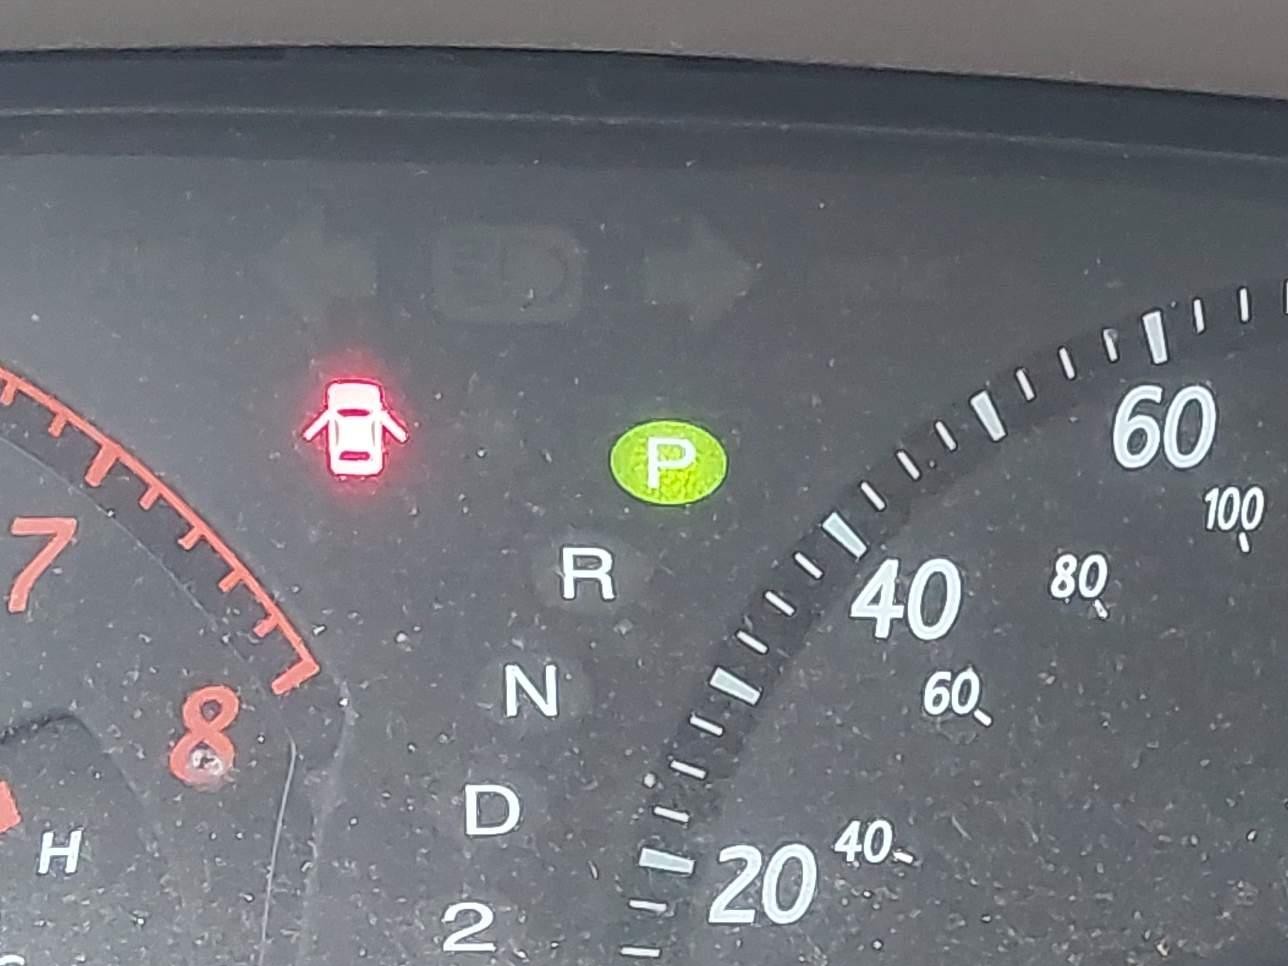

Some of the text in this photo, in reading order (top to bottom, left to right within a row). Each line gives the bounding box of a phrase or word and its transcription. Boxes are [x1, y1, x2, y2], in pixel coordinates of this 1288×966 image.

[1113, 385, 1217, 470] 60
[646, 436, 697, 489] P
[1205, 486, 1265, 531] 100
[9, 517, 78, 612] 7
[562, 546, 617, 601] R
[1051, 553, 1108, 600] 80
[851, 557, 962, 640] 40
[503, 663, 558, 718] N
[923, 670, 980, 716] 60
[169, 684, 240, 784] 8
[464, 783, 520, 836] D
[37, 829, 83, 875] H
[834, 820, 892, 863] 40
[708, 843, 817, 925] 20
[442, 901, 497, 953] 2
